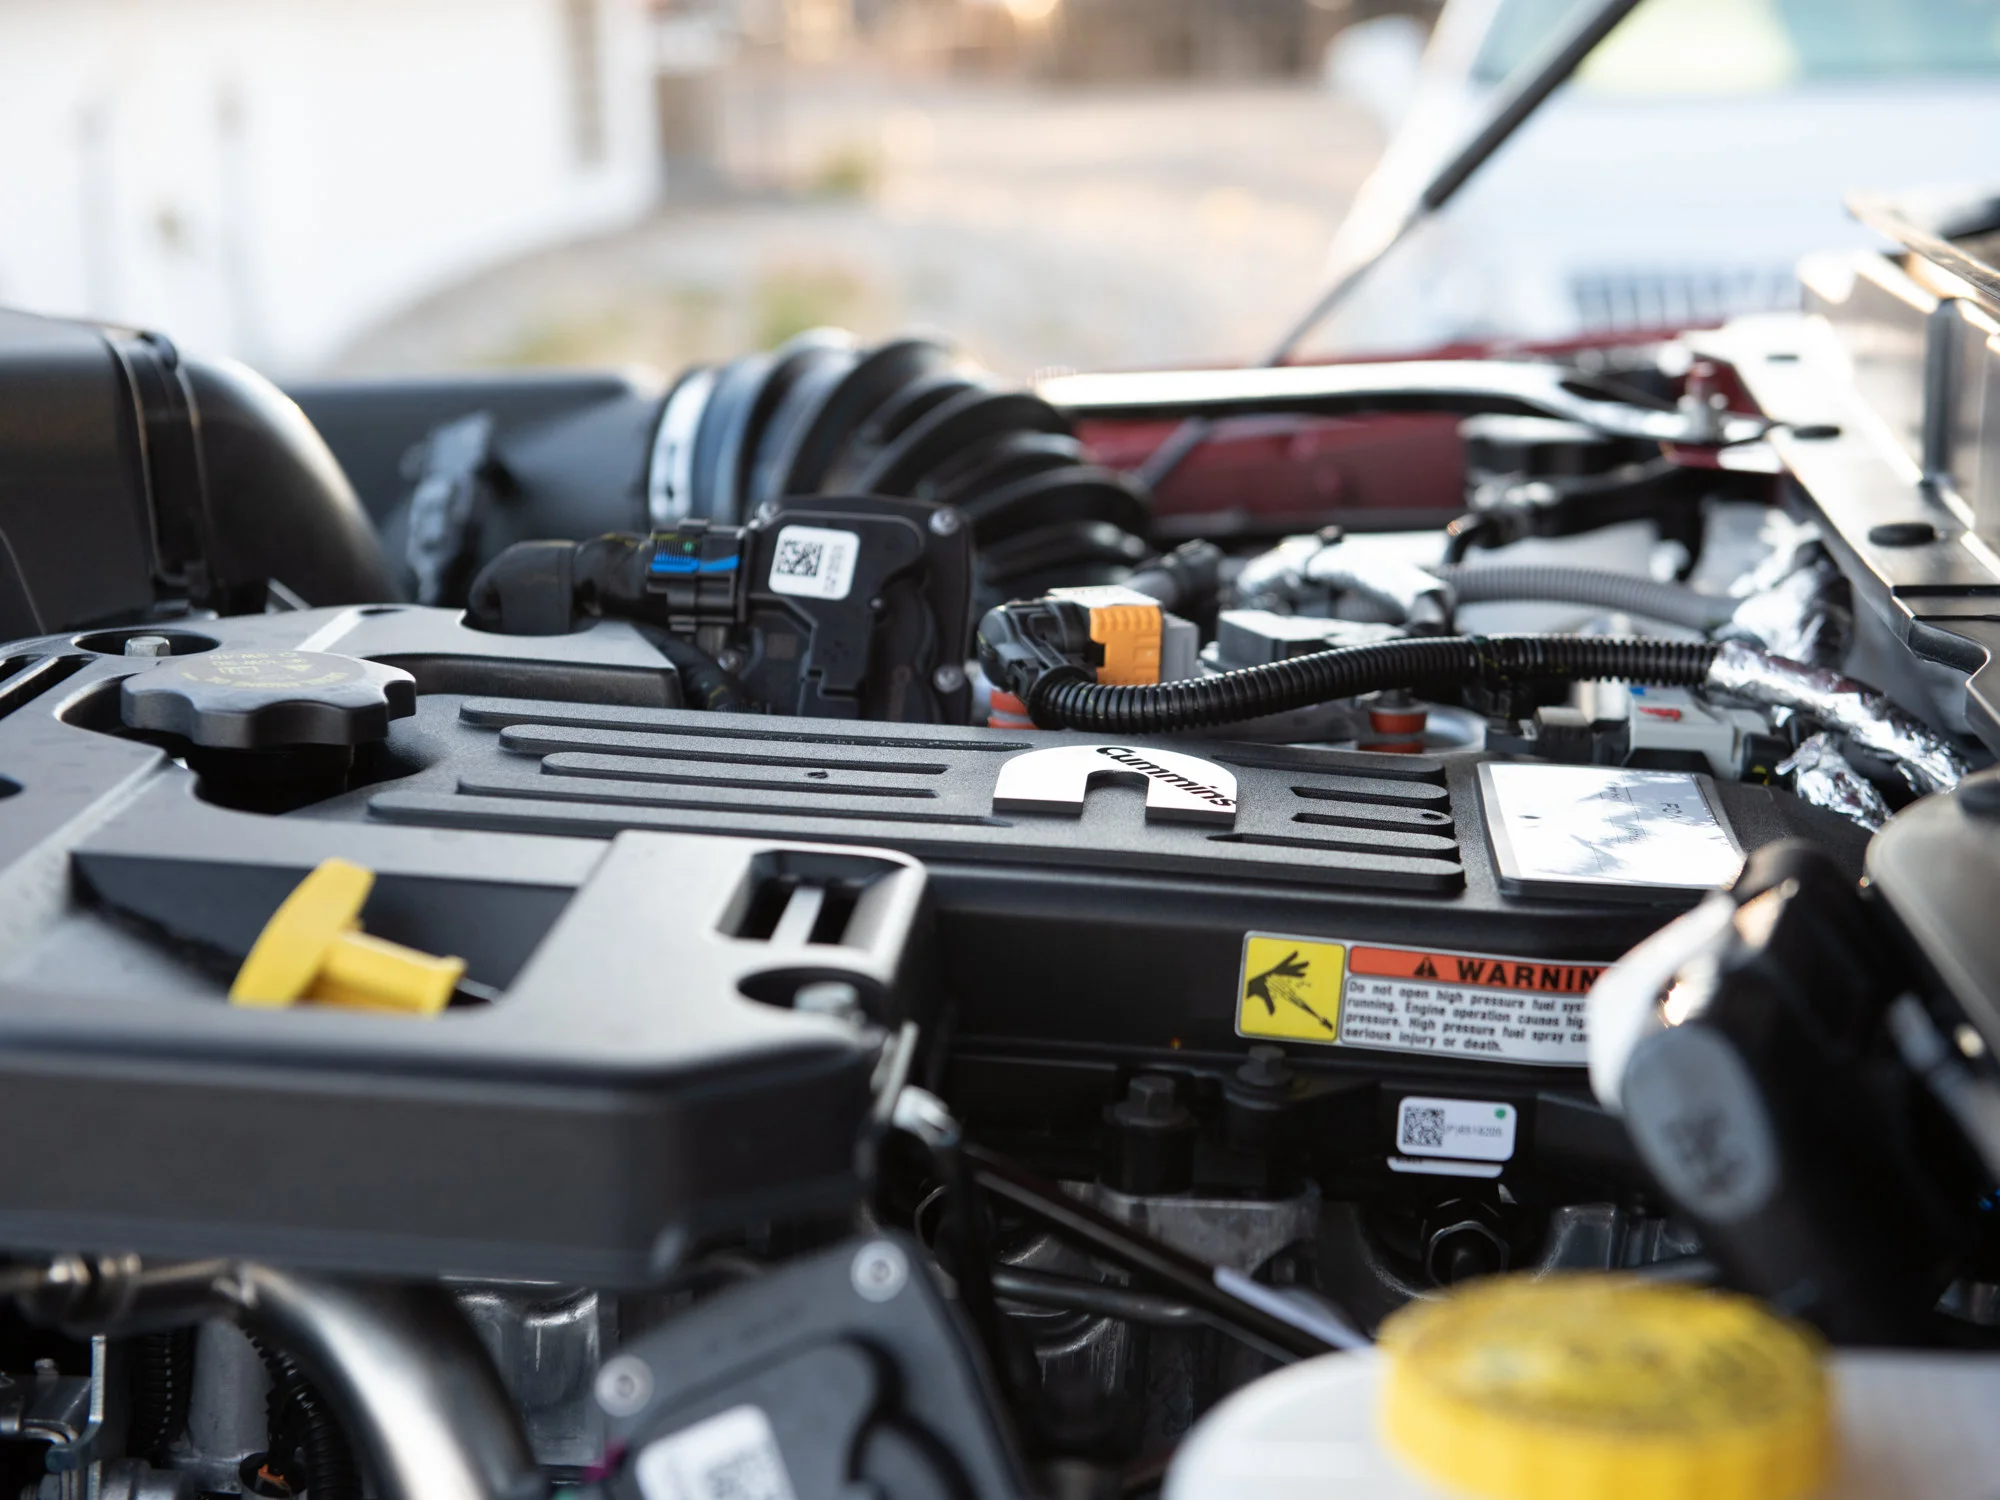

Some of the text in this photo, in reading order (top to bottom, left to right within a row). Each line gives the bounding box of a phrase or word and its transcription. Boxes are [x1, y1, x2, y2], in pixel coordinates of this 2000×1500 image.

[1095, 746, 1236, 807] Cummins
[1456, 959, 1599, 991] WARNIN
[1349, 982, 1365, 993] Do
[1372, 985, 1392, 995] not
[1399, 988, 1429, 999] open
[1436, 990, 1463, 1004] high
[1470, 994, 1525, 1009] pressure
[1532, 999, 1555, 1011] fuel
[1405, 1001, 1446, 1016] Engine
[1453, 1008, 1511, 1023] operation
[1518, 1014, 1559, 1026] causes
[1566, 1016, 1584, 1029] hig
[1345, 1028, 1503, 1052] serious injury or death.
[1409, 1017, 1436, 1032] High
[1443, 1022, 1496, 1036] pressure
[1502, 1026, 1526, 1039] fuel
[1532, 1031, 1565, 1045] spray
